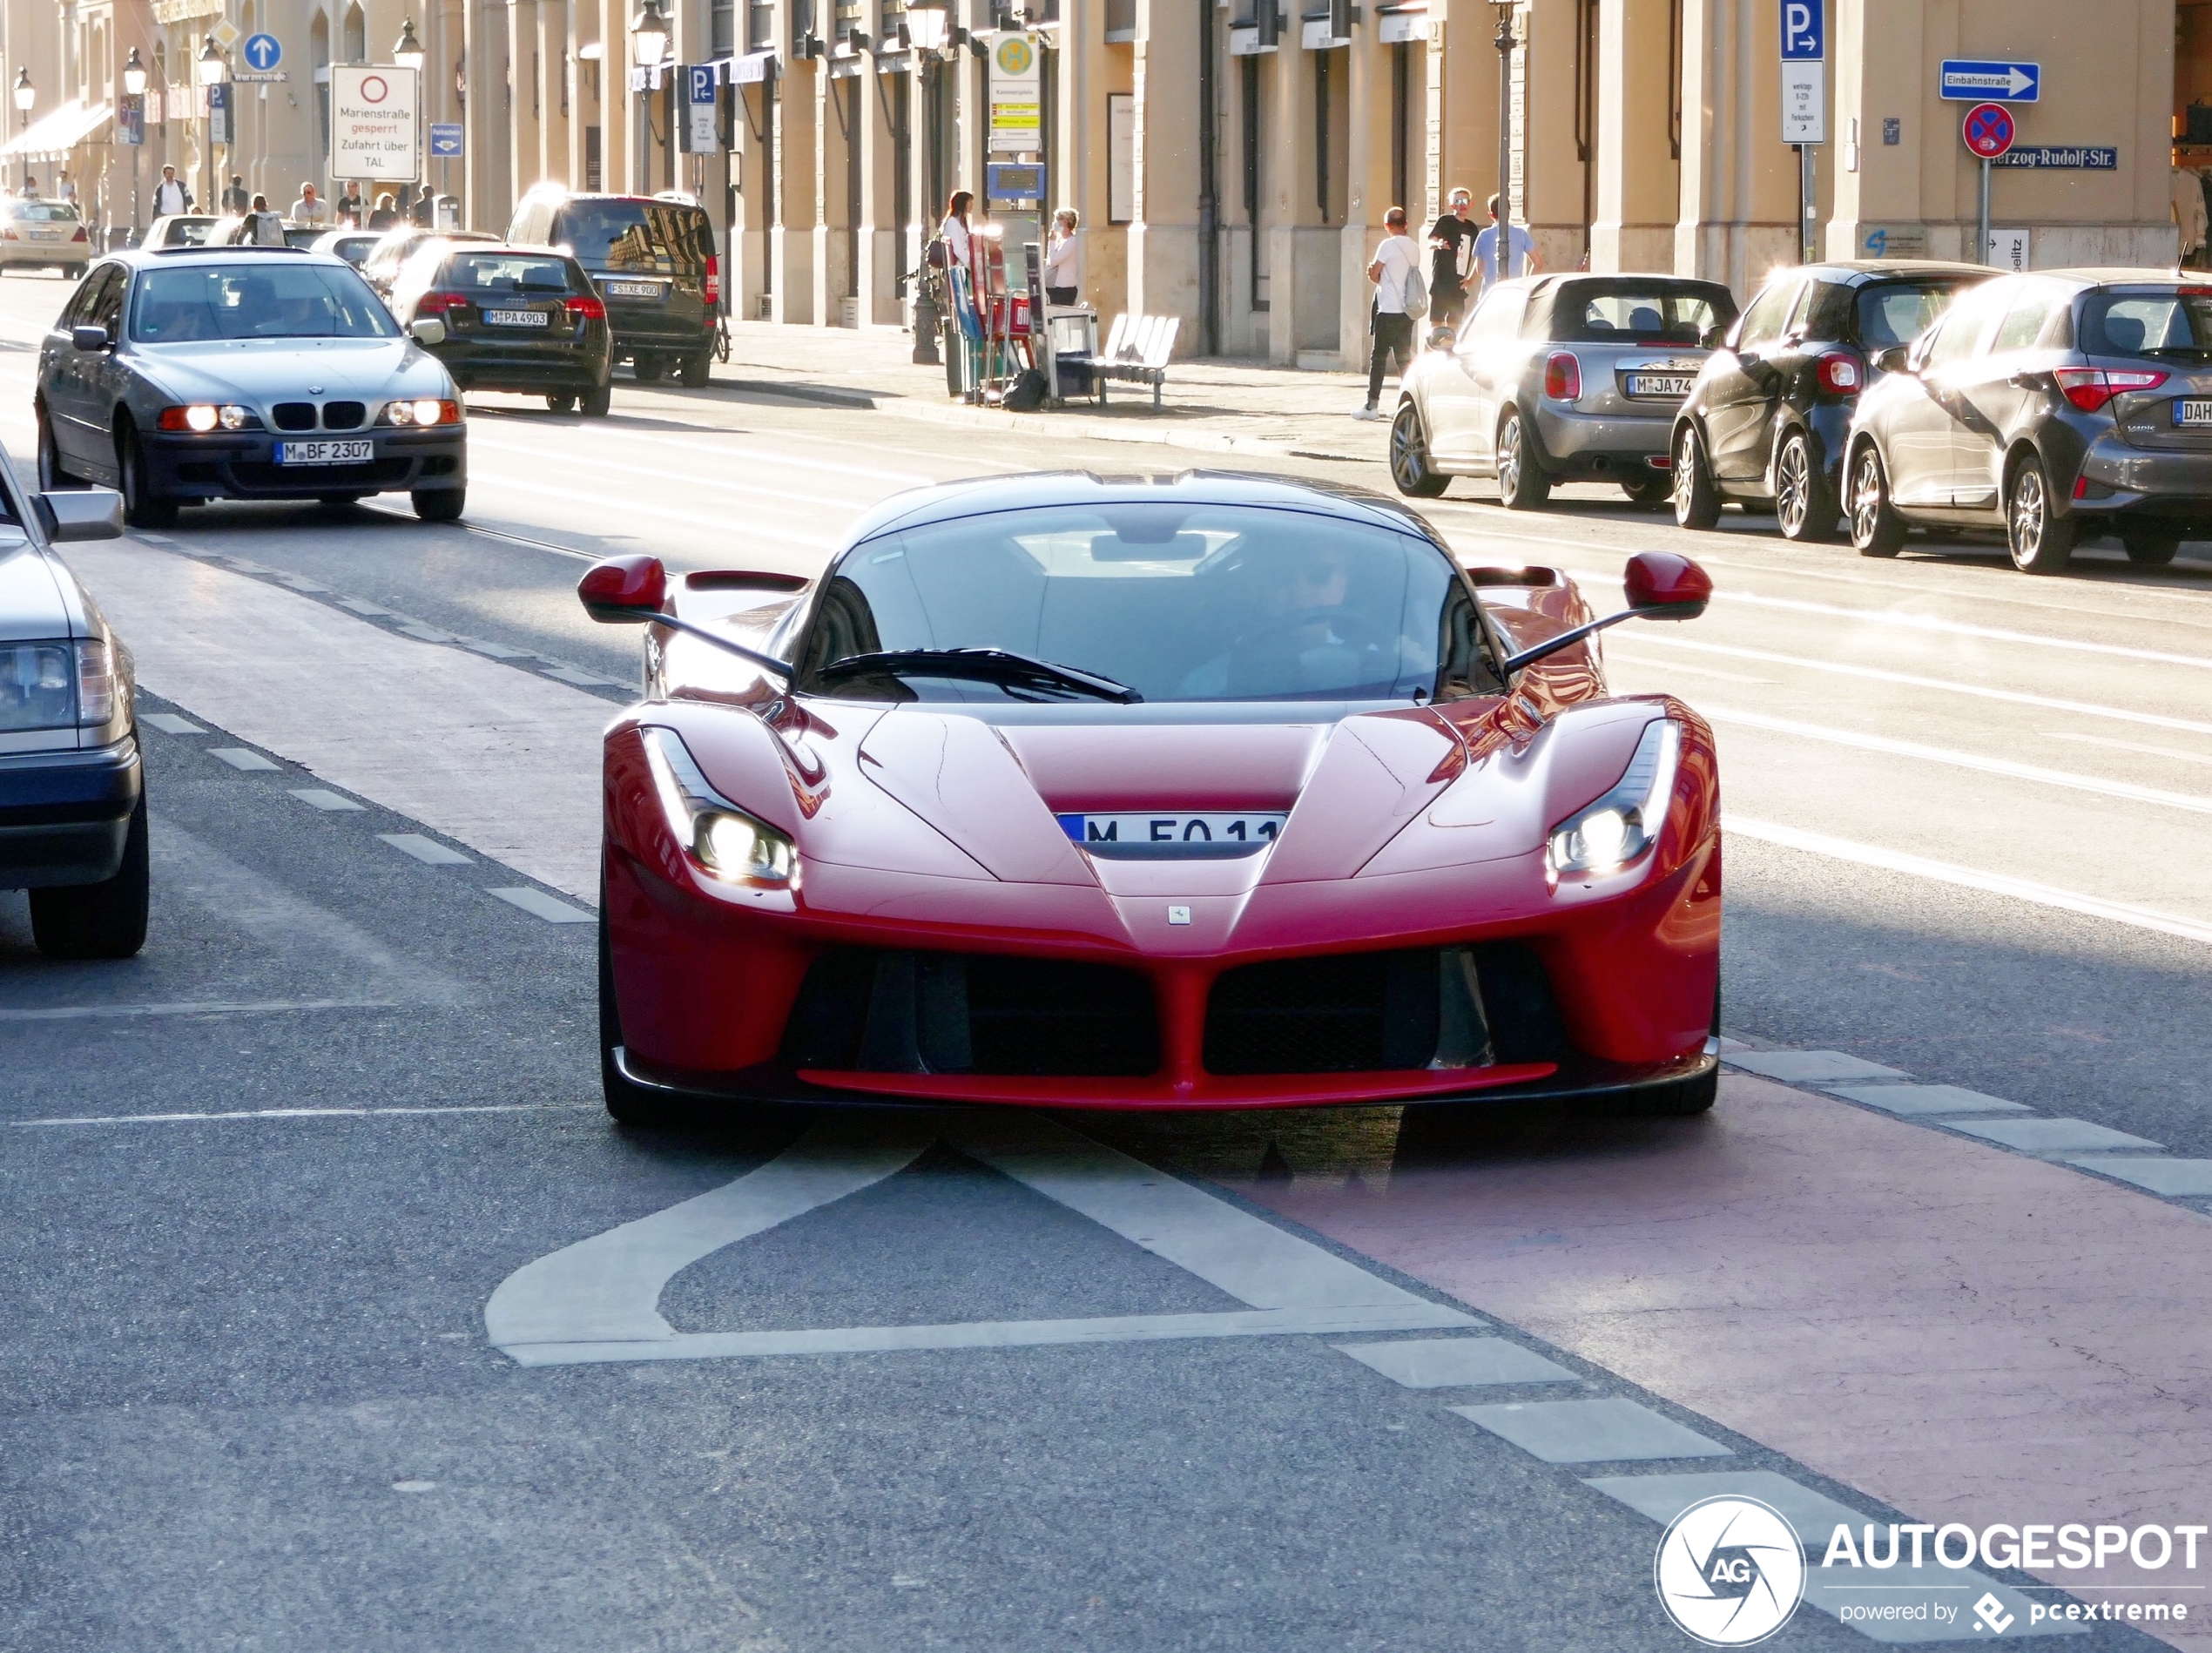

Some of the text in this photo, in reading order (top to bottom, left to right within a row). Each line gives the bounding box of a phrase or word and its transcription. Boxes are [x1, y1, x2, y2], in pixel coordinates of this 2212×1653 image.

[1787, 3, 1810, 51] P
[693, 70, 707, 99] P
[1947, 76, 2012, 87] Einbahnstraße
[212, 87, 221, 105] P
[340, 107, 411, 119] Marienstraße
[351, 124, 397, 135] gesperrt
[341, 139, 408, 151] Zufahrt über
[364, 158, 385, 167] TAL
[612, 284, 657, 294] FS XE 900
[491, 312, 545, 324] M PA 4903
[1637, 378, 1646, 392] M
[1655, 379, 1672, 393] JA
[2184, 403, 2212, 420] DAH
[285, 444, 296, 459] M
[307, 443, 327, 459] BF
[331, 442, 370, 458] 2307
